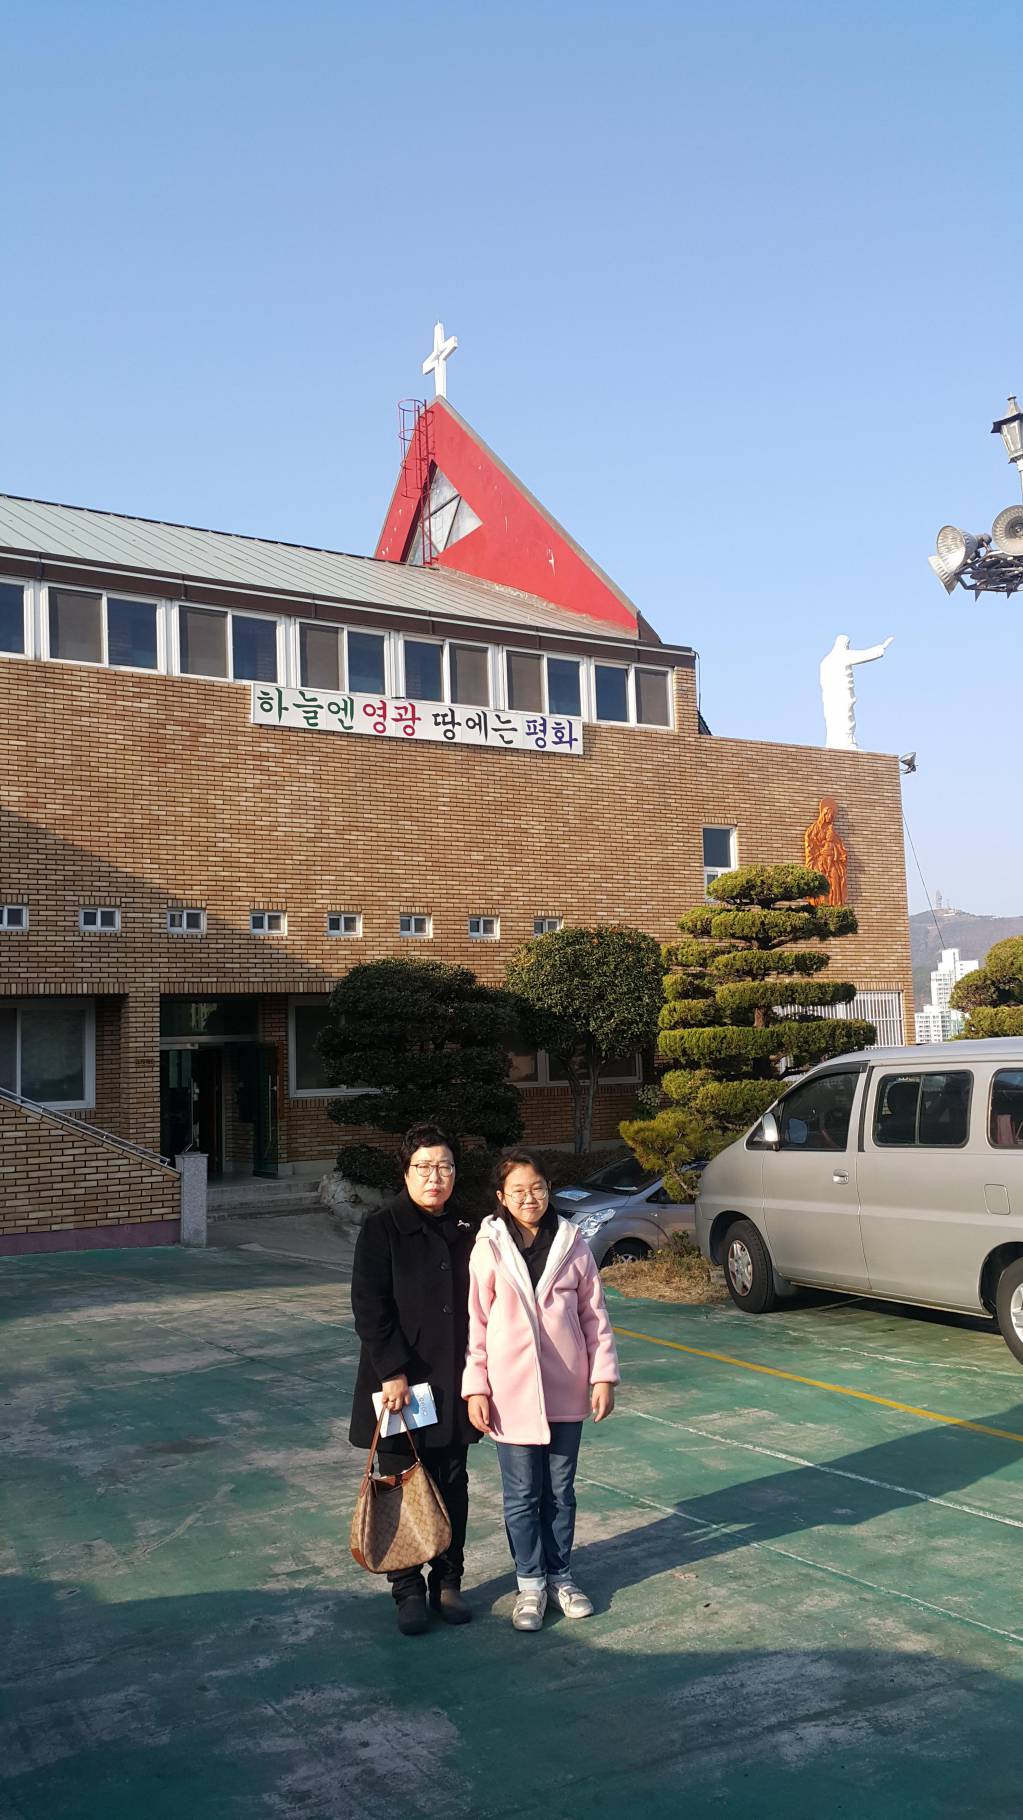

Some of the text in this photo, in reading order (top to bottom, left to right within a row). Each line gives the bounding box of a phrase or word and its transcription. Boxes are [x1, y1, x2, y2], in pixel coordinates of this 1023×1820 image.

[257, 689, 578, 749] 하늘엔 영광 땅에는 평화
